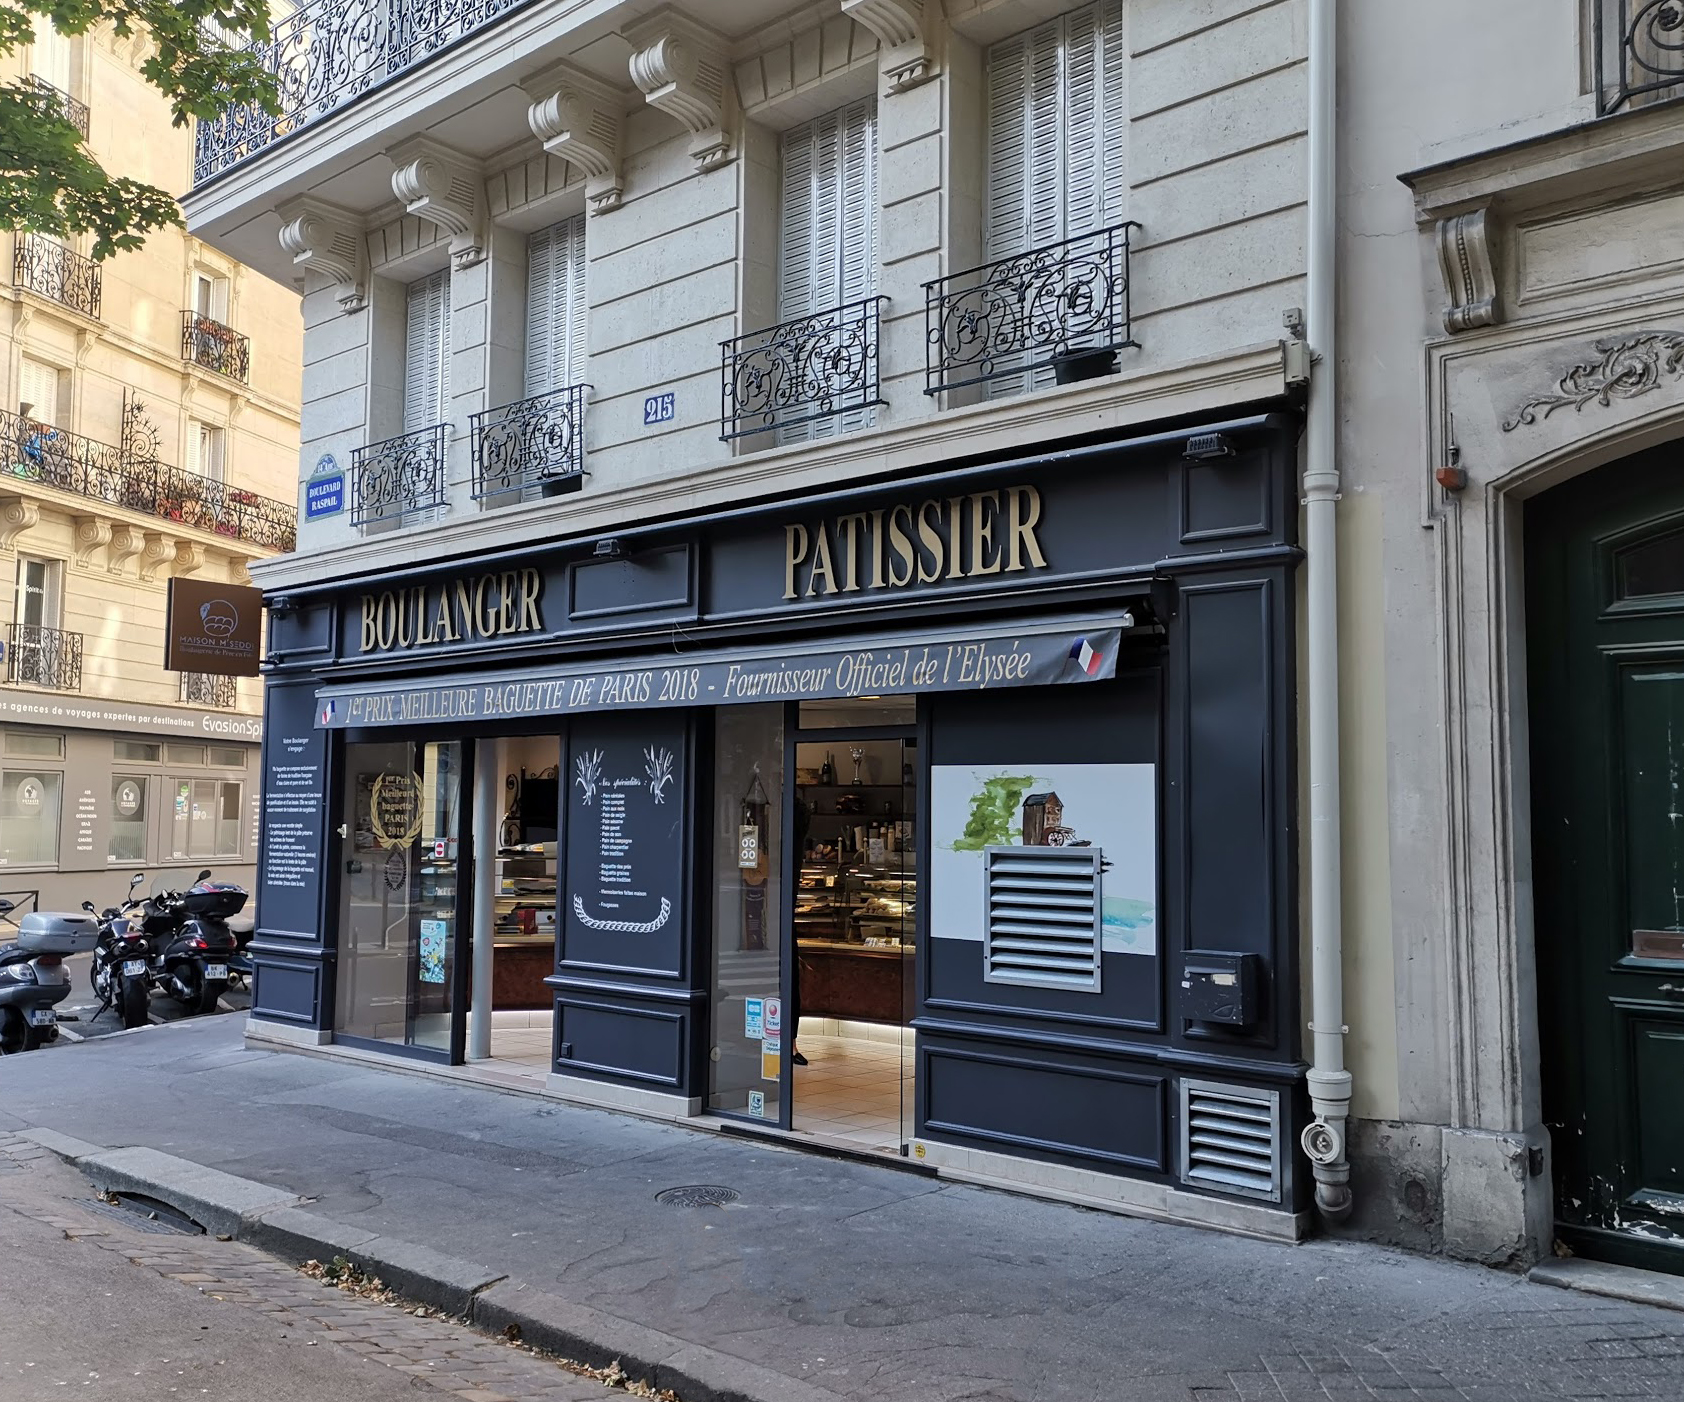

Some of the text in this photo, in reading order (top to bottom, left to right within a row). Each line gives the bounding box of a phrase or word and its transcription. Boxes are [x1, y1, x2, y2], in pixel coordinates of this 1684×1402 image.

[646, 395, 672, 422] 215
[310, 481, 340, 498] BOULEVARD
[312, 496, 338, 511] RASPAIL
[782, 485, 1047, 599] PATISSIER
[358, 568, 542, 652] BOULANGER
[180, 636, 216, 646] MAISON
[364, 696, 395, 722] PRIX
[399, 688, 477, 720] MEILLEURE
[482, 680, 565, 715] BAGUETTE
[569, 678, 596, 707] DE
[598, 672, 652, 703] PARIS
[658, 668, 700, 701] 2018
[723, 663, 832, 698] Fournisseur
[836, 650, 909, 696] Officiel
[913, 648, 938, 685] de
[943, 641, 1031, 689] l'Elysée
[11, 703, 48, 713] agences
[52, 706, 62, 714] de
[66, 709, 100, 718] voyages
[104, 712, 136, 721] expertes
[138, 716, 150, 724] par
[153, 716, 194, 727] destinations
[203, 716, 263, 738] EvasionSpi
[385, 814, 408, 822] PARIS
[388, 827, 404, 835] 2018
